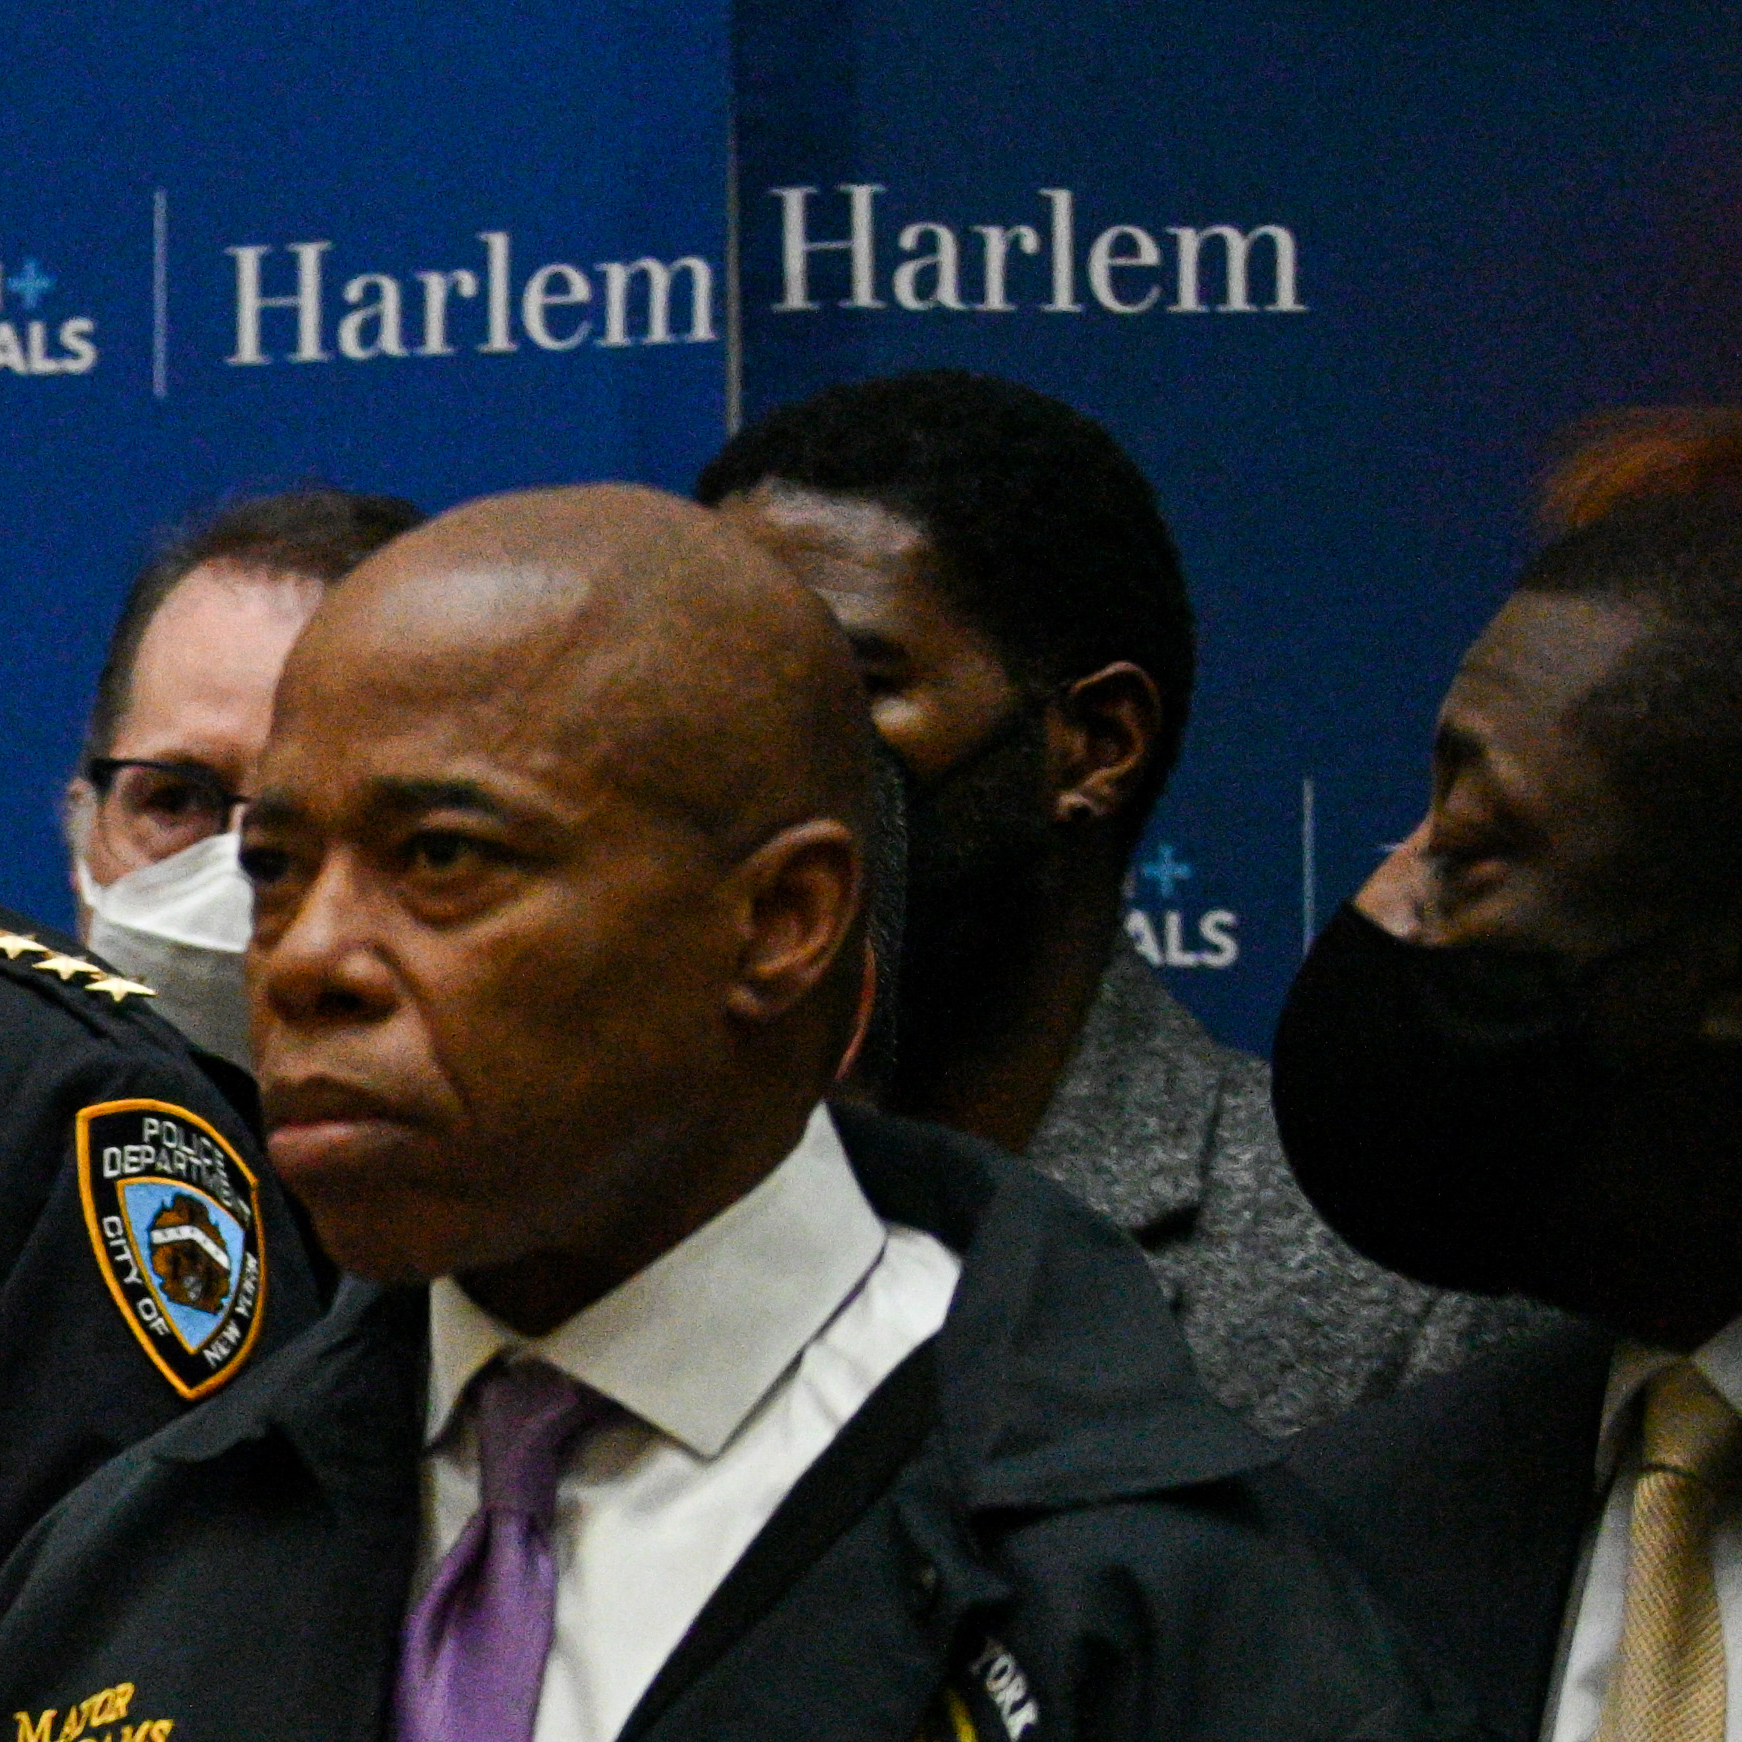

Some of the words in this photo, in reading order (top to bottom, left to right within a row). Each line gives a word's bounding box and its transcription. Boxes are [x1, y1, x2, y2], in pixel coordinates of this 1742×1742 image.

[224, 230, 718, 366] Harlem
[768, 183, 1310, 314] Harlem
[101, 1215, 144, 1285] CITY
[136, 1296, 171, 1337] OF
